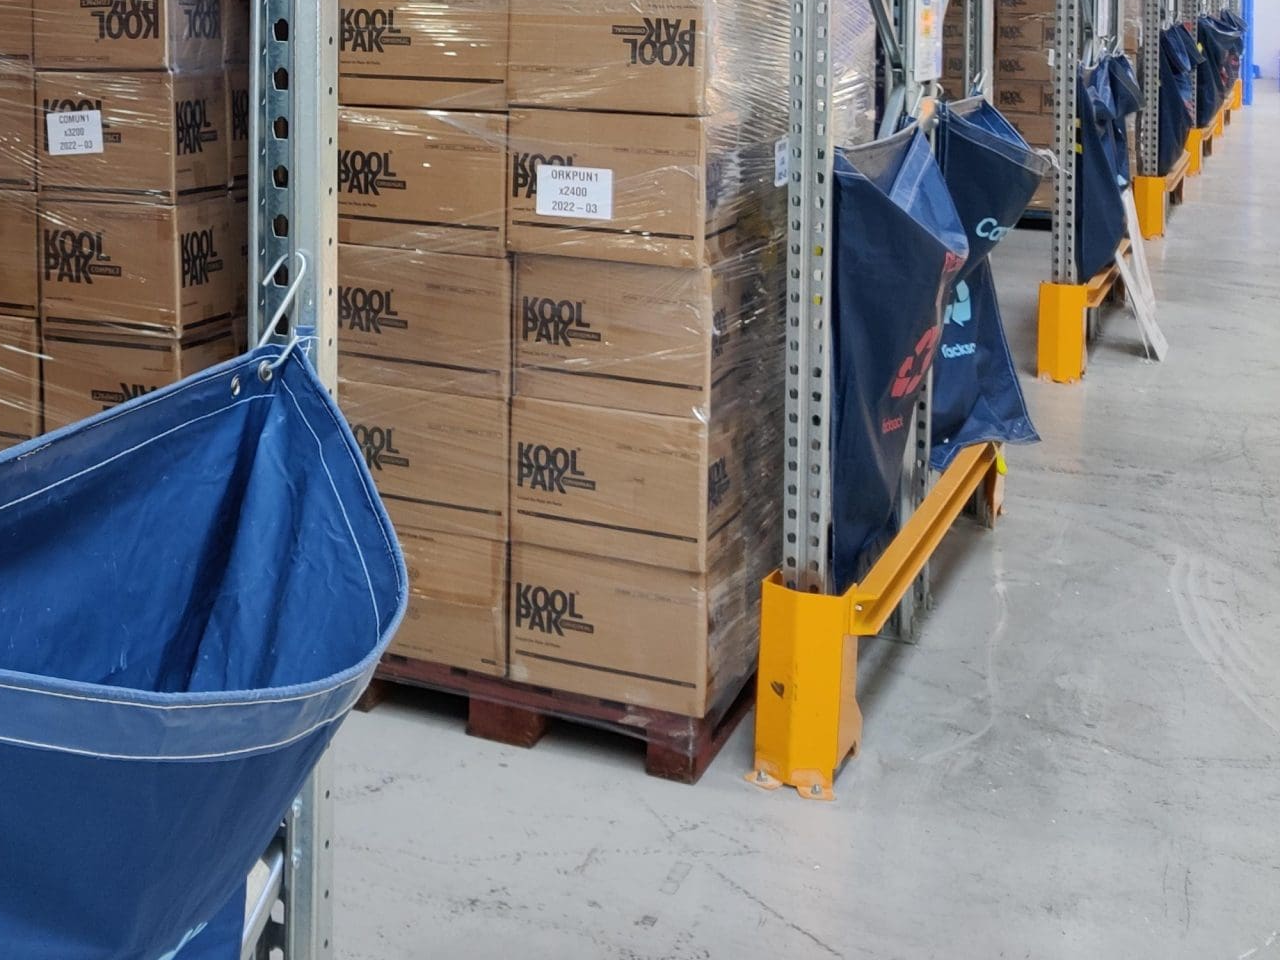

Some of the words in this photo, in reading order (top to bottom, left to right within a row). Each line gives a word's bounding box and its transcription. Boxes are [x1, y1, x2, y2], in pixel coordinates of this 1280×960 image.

[340, 8, 401, 34] KOOL
[643, 17, 696, 44] PAK
[340, 29, 384, 54] PAK
[622, 38, 696, 67] KOOL
[551, 169, 599, 183] ORKPUN1
[559, 187, 588, 198] x2400
[44, 229, 110, 262] KOOL
[44, 254, 93, 284] PAK
[522, 295, 591, 329] KOOL
[522, 321, 571, 347] PAK
[517, 441, 585, 477] KOOL
[517, 468, 567, 494] PAK
[516, 582, 583, 619] KOOL
[516, 610, 565, 637] PAK
